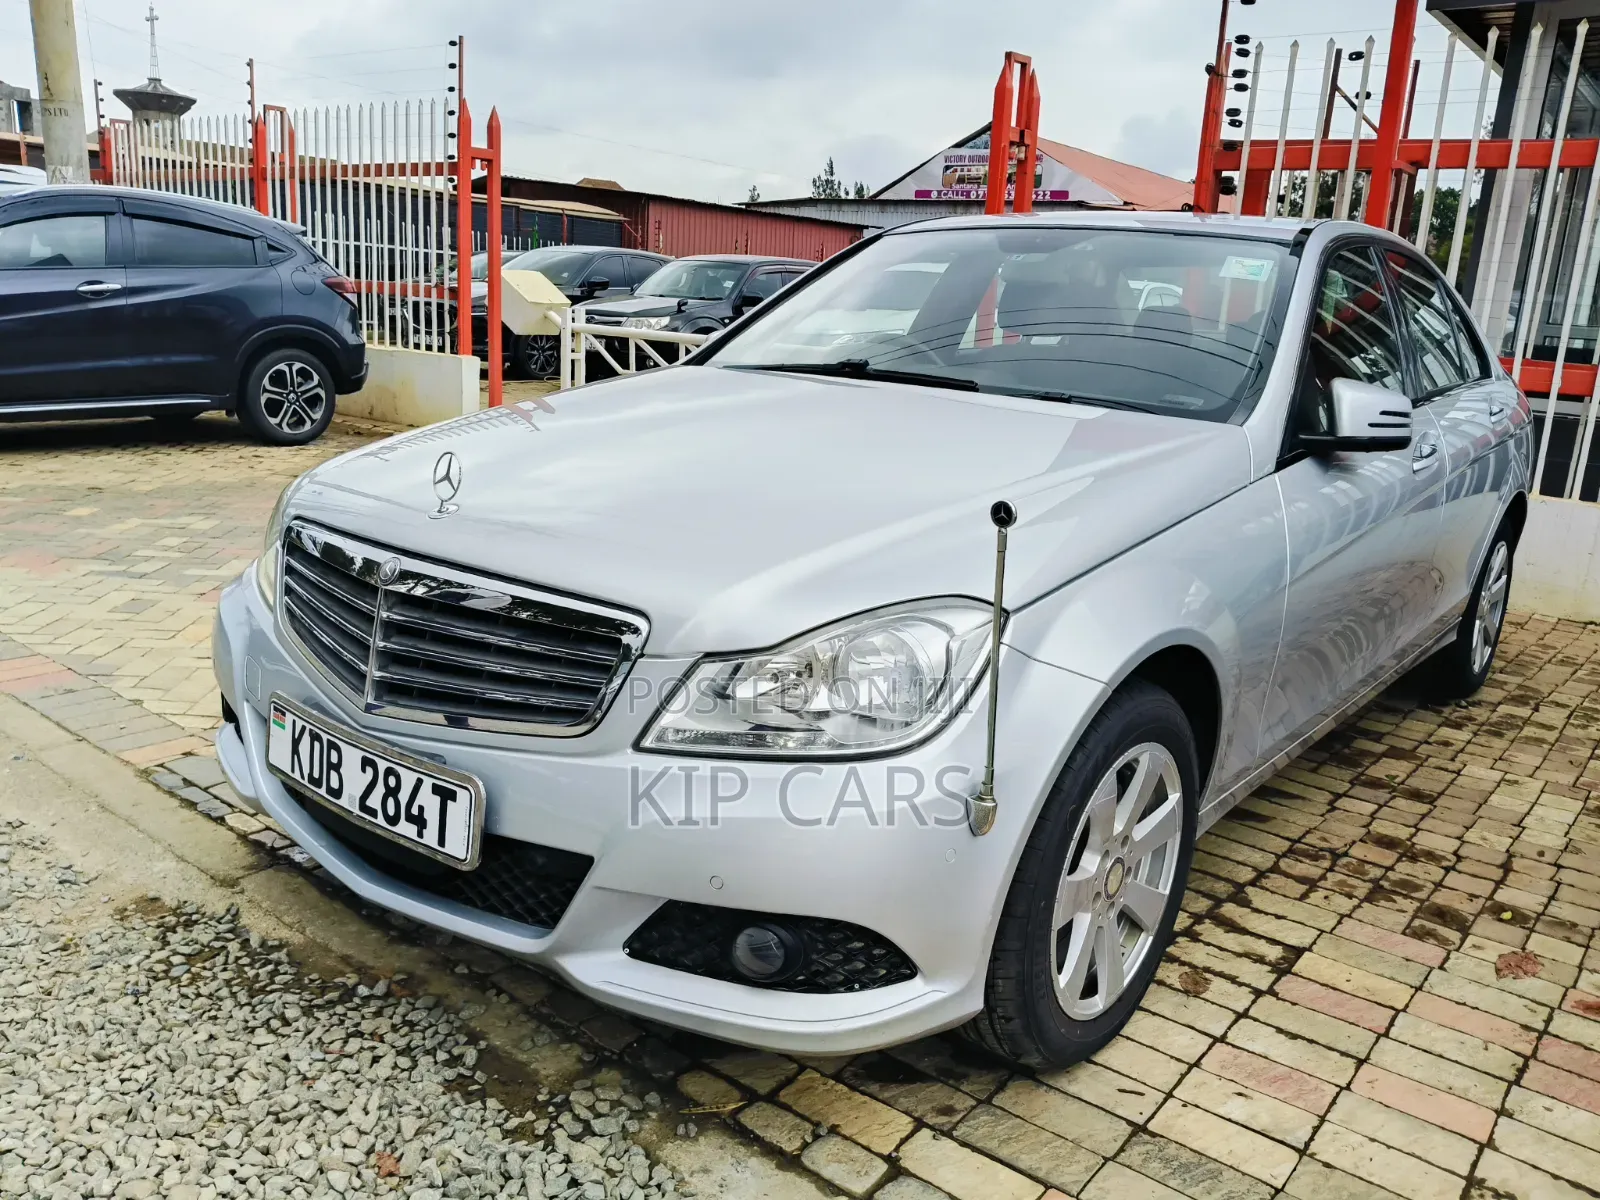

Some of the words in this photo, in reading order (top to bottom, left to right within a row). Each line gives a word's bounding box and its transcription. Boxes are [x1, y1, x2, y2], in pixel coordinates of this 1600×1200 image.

[944, 154, 967, 164] VICTORY
[968, 154, 990, 163] OUTDOO
[941, 190, 966, 199] CALL:
[291, 719, 343, 800] KDB
[359, 755, 457, 848] 284T
